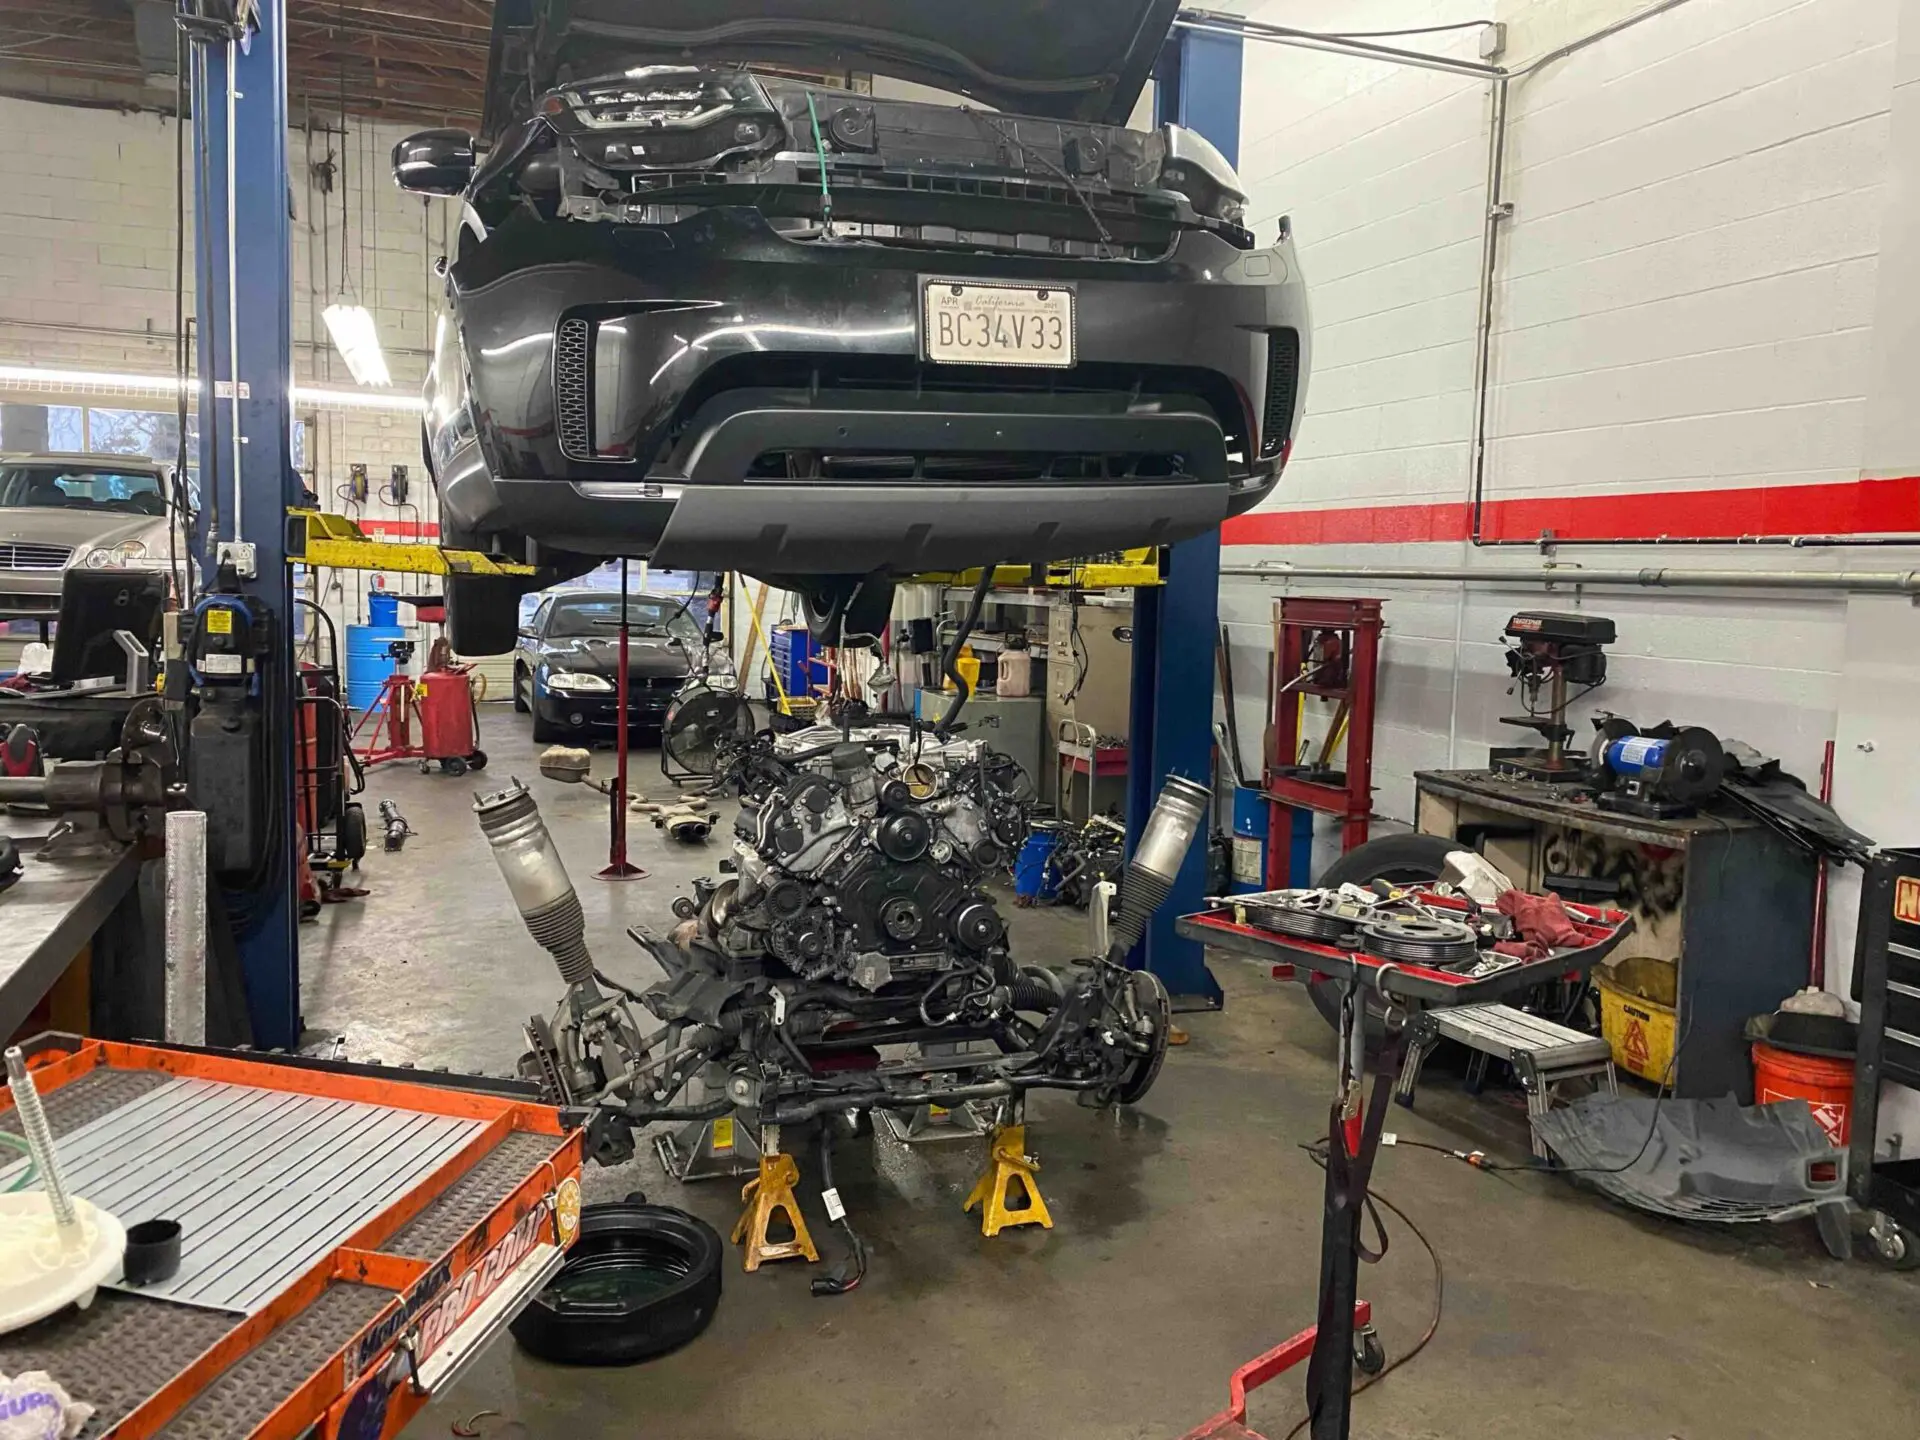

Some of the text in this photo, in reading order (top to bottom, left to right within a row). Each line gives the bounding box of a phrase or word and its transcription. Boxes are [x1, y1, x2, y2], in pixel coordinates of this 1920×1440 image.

[940, 296, 959, 305] APR
[974, 293, 1025, 311] California
[938, 311, 1062, 350] BC34V33
[419, 1201, 548, 1359] PRO COMP
